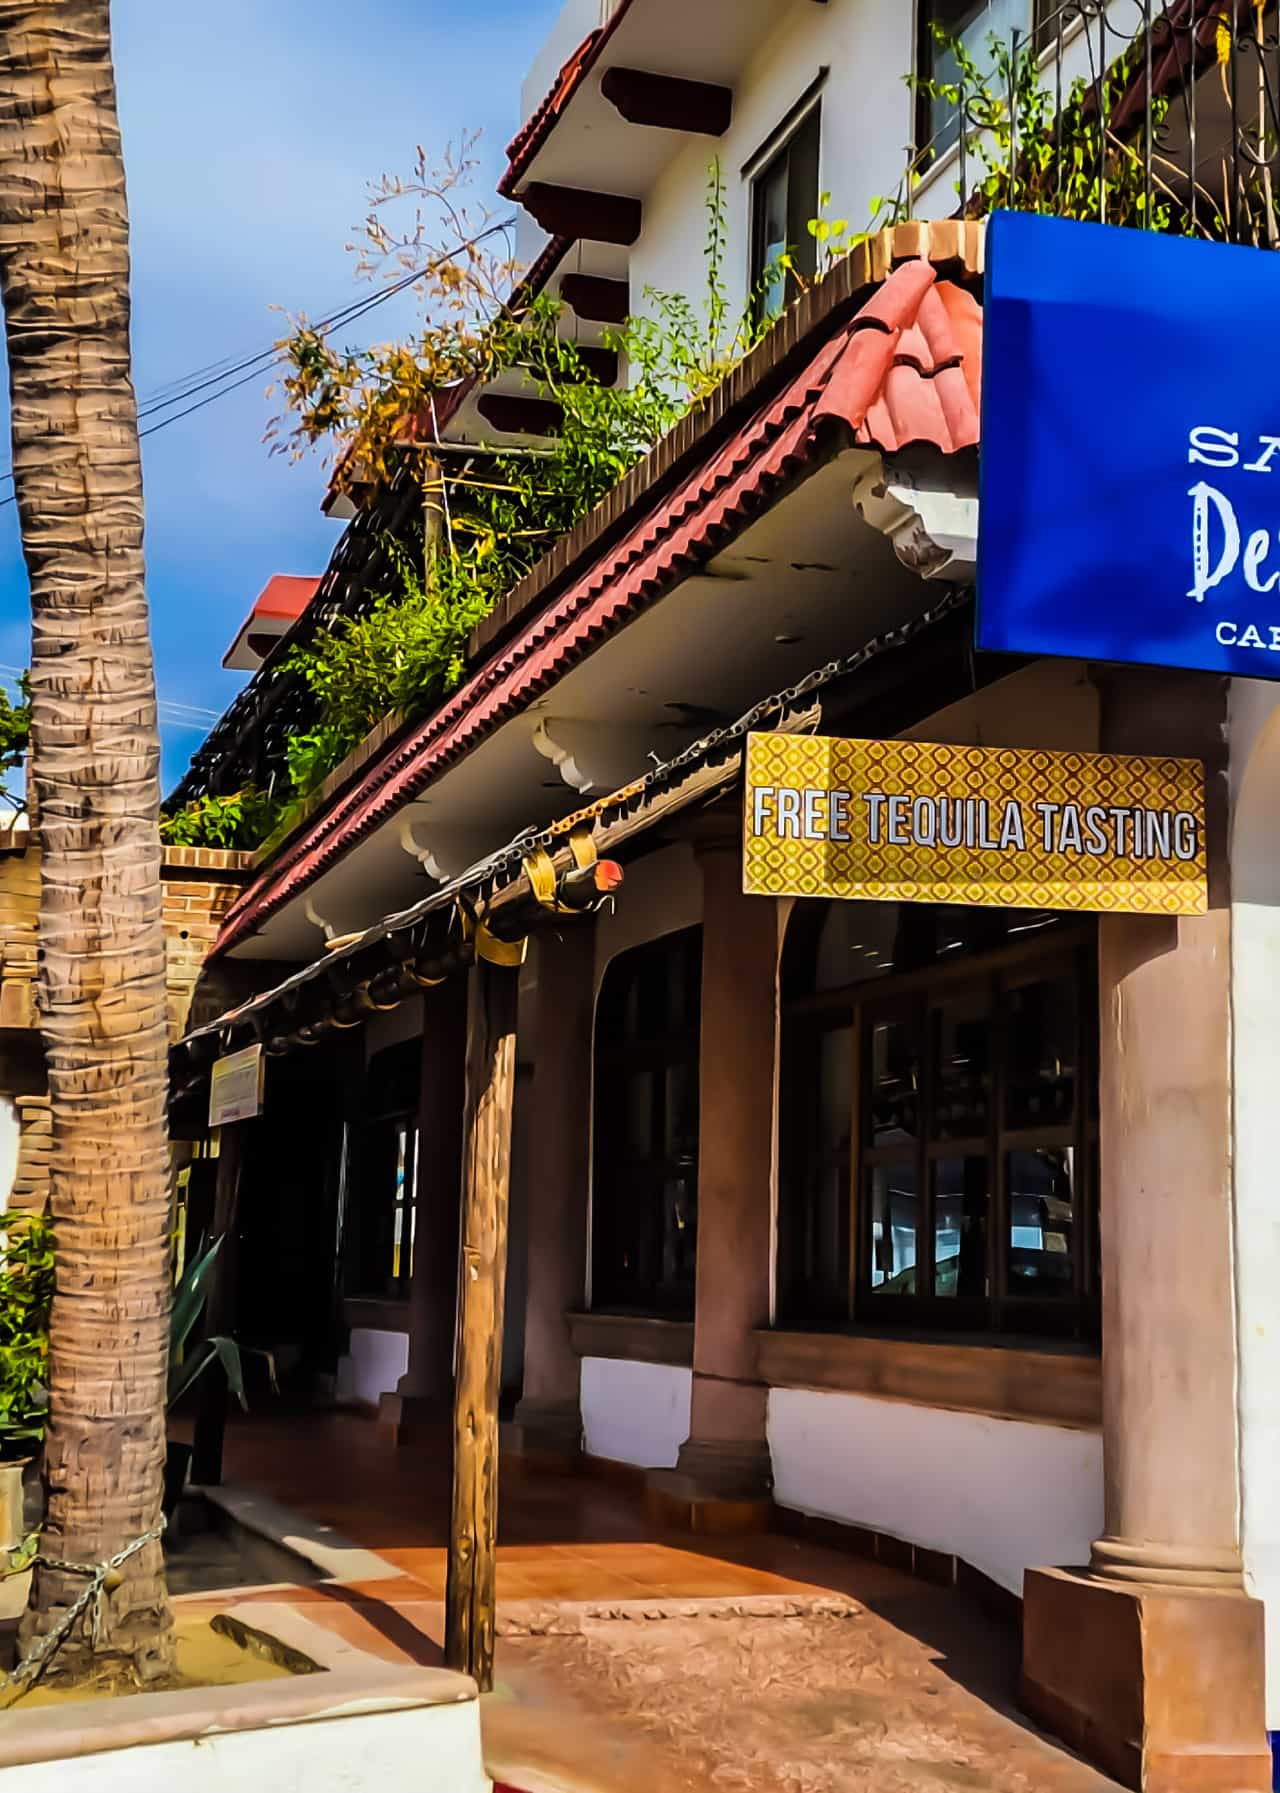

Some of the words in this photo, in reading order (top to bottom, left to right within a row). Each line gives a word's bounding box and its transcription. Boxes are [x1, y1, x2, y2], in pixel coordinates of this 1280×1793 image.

[752, 786, 852, 843] FREE
[863, 792, 1027, 852] TEQUILA
[1036, 802, 1198, 862] TASTING
